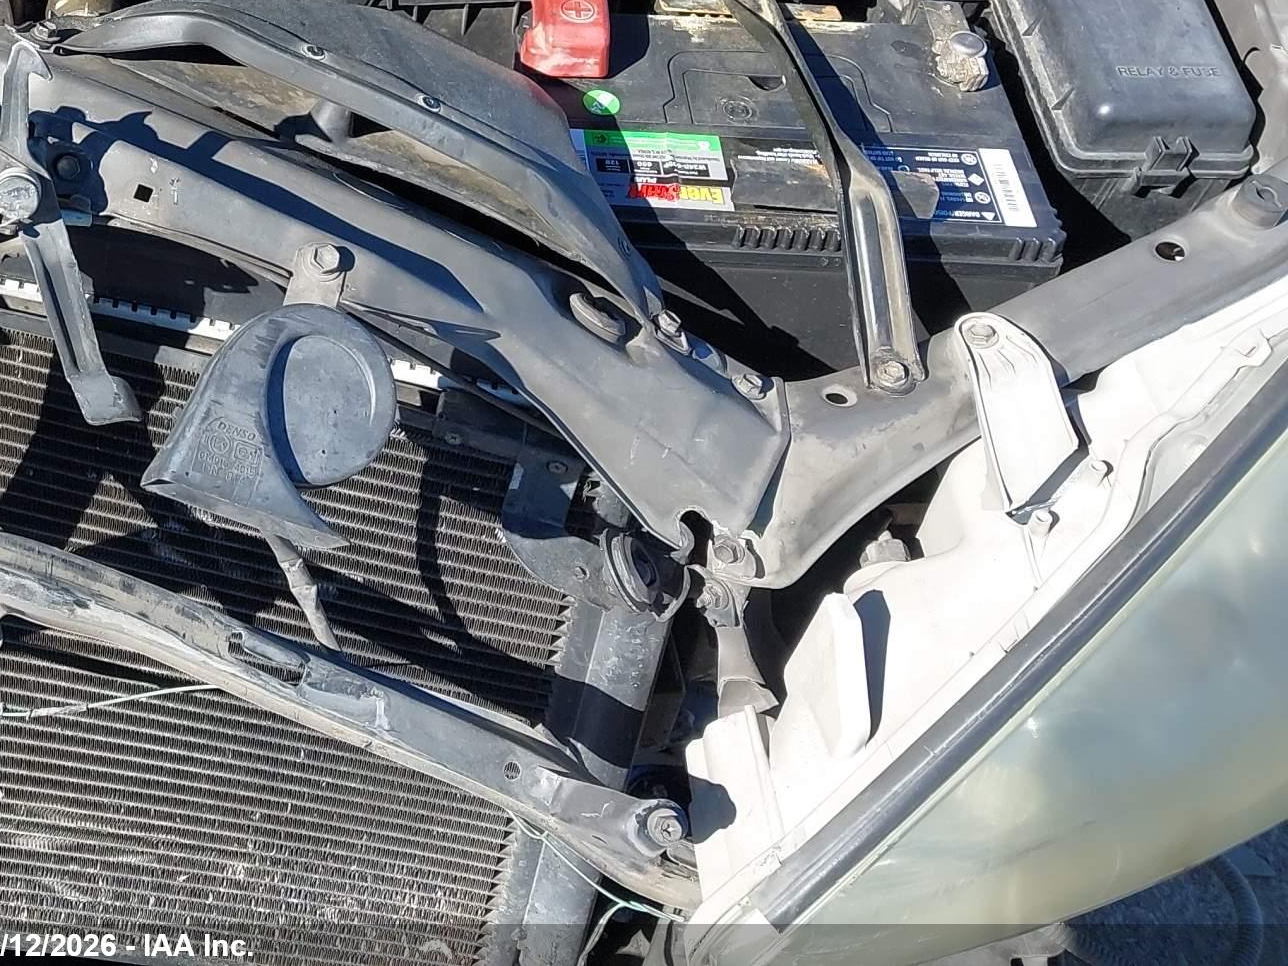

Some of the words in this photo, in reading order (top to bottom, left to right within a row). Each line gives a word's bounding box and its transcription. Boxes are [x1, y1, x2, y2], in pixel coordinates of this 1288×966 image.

[1116, 65, 1164, 78] RELAY
[1168, 65, 1180, 78] &
[1181, 65, 1223, 78] FUSE
[216, 421, 256, 440] DENSO
